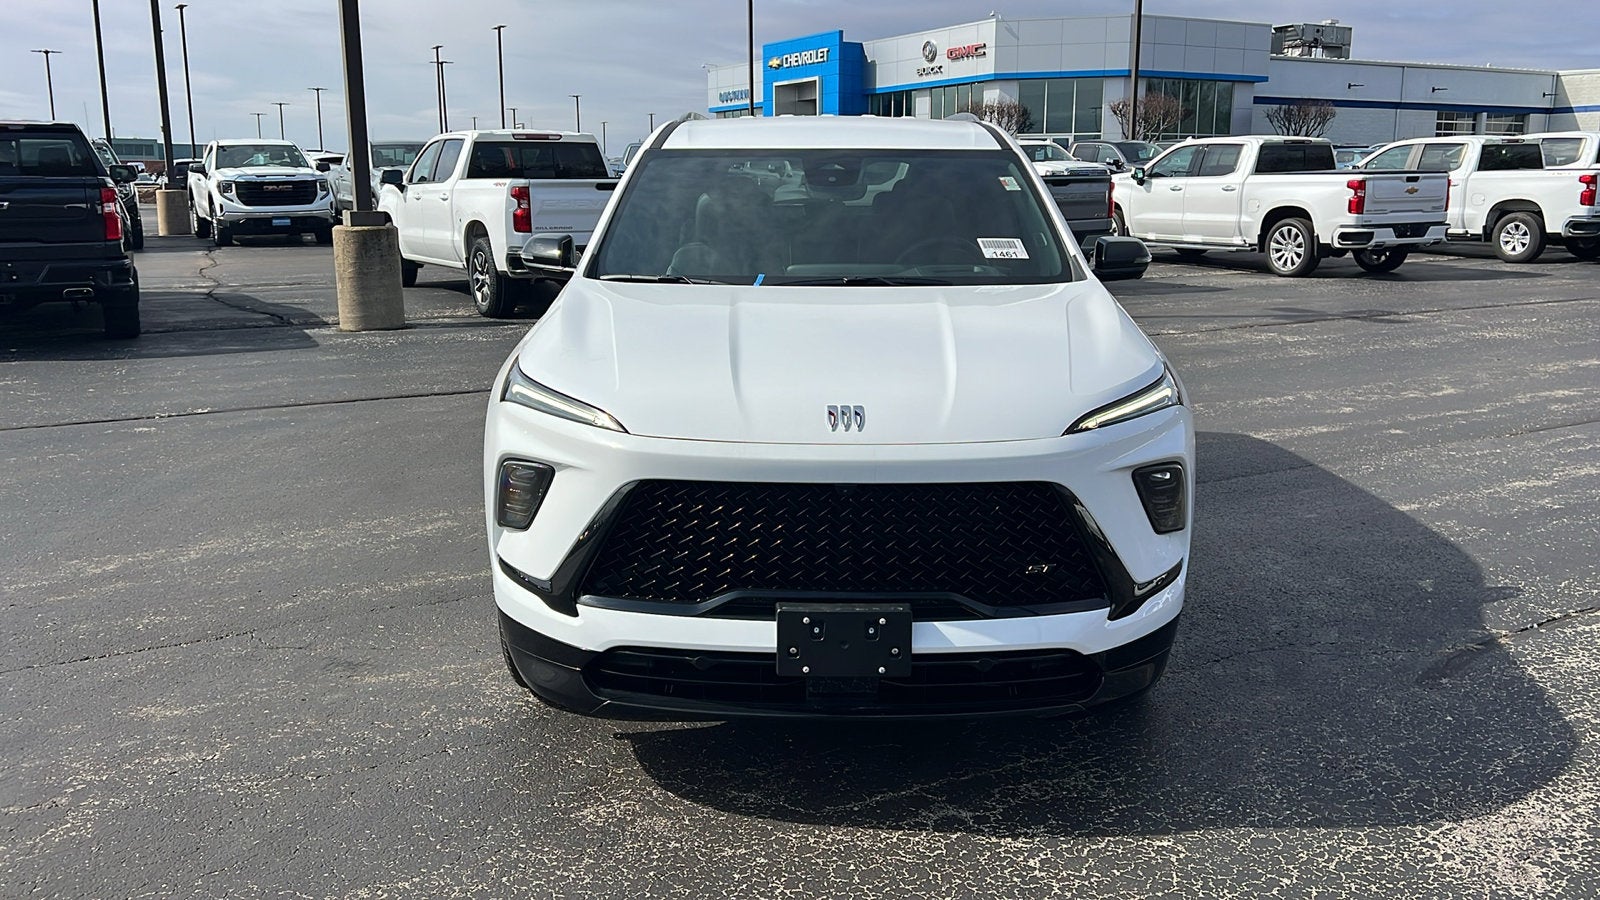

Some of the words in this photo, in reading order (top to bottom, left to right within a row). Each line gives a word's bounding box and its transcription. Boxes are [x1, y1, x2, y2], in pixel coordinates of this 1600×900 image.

[783, 48, 828, 68] CHEVROLET
[947, 43, 988, 60] GMC
[916, 65, 944, 76] BUICK
[993, 250, 1018, 258] 1461
